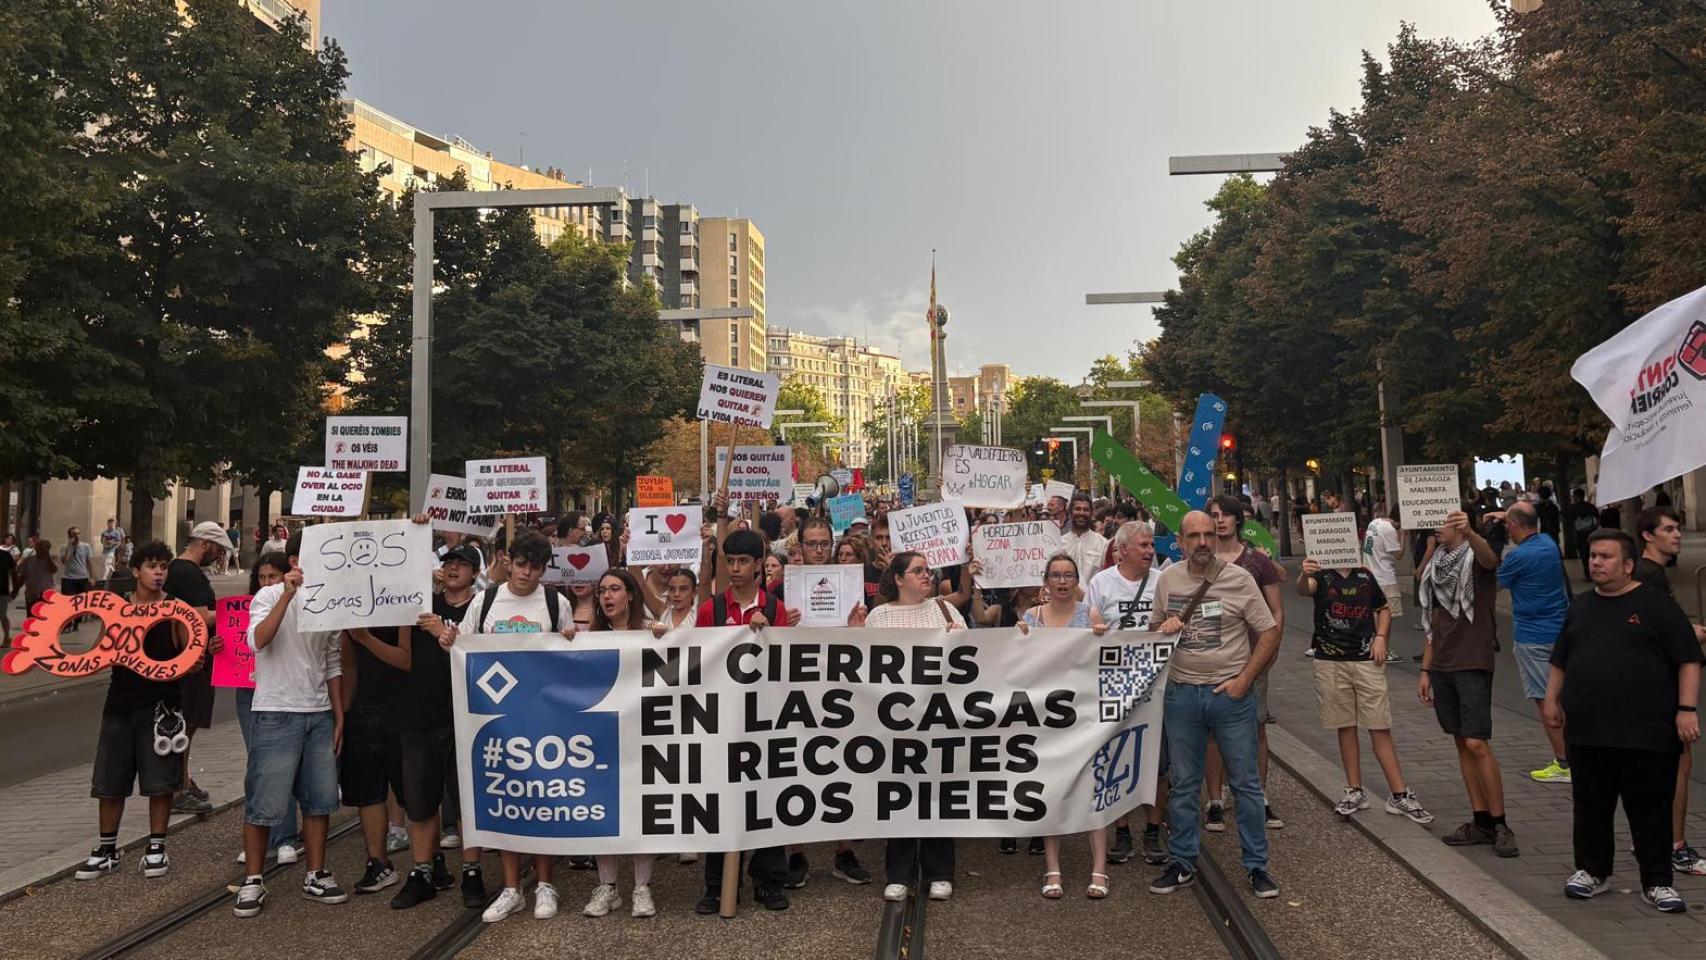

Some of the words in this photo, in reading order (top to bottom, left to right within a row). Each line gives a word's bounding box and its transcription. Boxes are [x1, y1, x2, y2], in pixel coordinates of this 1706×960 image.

[717, 371, 728, 380] ES
[730, 374, 764, 389] LITERAL
[709, 383, 728, 395] NOS
[729, 387, 767, 403] QUIEREN
[717, 398, 749, 413] QUITAR
[698, 408, 710, 419] LA
[712, 411, 731, 423] VIDA
[331, 426, 339, 435] SI
[340, 424, 370, 436] QUERÉIS
[371, 425, 402, 436] ZOMBIES
[351, 444, 361, 452] OS
[362, 441, 379, 453] VÉIS
[750, 451, 785, 462] QUITÁIS
[331, 460, 346, 469] THE
[347, 460, 379, 470] WALKING
[380, 460, 399, 470] DEAD
[479, 465, 492, 474] ES
[493, 463, 531, 473] LITERAL
[733, 466, 745, 474] EL
[746, 466, 770, 476] OCIO,
[955, 458, 970, 474] ES
[1400, 465, 1455, 474] AYUNTAMIENTO
[306, 471, 321, 479] NO
[322, 471, 334, 479] AL
[745, 476, 780, 487] QUITÁIS
[974, 472, 1012, 490] HOGAR
[1404, 477, 1414, 485] DE
[1415, 475, 1451, 484] ZARAGOZA
[301, 482, 326, 490] OVER
[341, 483, 363, 491] OCIO
[475, 478, 494, 488] NOS
[496, 477, 536, 487] QUIEREN
[316, 493, 330, 502] EN
[331, 494, 343, 502] LA
[445, 486, 467, 501] ERRO
[486, 490, 521, 500] QUITAR
[744, 489, 780, 500] SUEÑOS
[1409, 486, 1447, 495] MALTRATA
[311, 505, 345, 513] CIUDAD
[427, 506, 449, 521] OCIO
[449, 509, 467, 521] NOT
[470, 505, 481, 514] LA
[484, 504, 506, 513] VIDA
[507, 503, 540, 513] SOCIAL
[1425, 509, 1448, 517] ZONAS
[645, 514, 659, 535] I
[895, 517, 906, 532] LA
[906, 506, 955, 526] JUVENTUD
[1304, 517, 1354, 526] AYUNTAMIENTO
[900, 525, 941, 544] NECESITA
[942, 522, 960, 535] SER
[983, 522, 1025, 539] HORIZON
[1028, 522, 1043, 535] CON
[1318, 527, 1351, 535] ZARAGOZA
[948, 535, 959, 546] NO
[986, 538, 1011, 551] ZONA
[1316, 537, 1346, 545] MARGINA
[631, 549, 662, 561] ZONA
[664, 547, 699, 561] JOVEN
[1324, 548, 1356, 556] JUVENTUD
[547, 553, 560, 569] I
[303, 584, 363, 614] Zonas
[352, 575, 424, 617] Jóvenes
[120, 603, 159, 619] CASAS
[162, 601, 204, 650] juventud
[99, 622, 145, 654] SOS
[34, 643, 101, 674] ZONAS
[109, 652, 178, 679] JOVENES
[642, 646, 702, 687] NI
[726, 642, 979, 686] CIERRES
[641, 693, 719, 736] EN
[745, 688, 855, 733] LAS
[877, 689, 1077, 732] CASAS
[482, 734, 608, 771] #SOS_
[642, 743, 701, 785] NI
[728, 734, 1039, 784] RECORTES
[485, 771, 586, 799] Zonas
[1093, 783, 1121, 812] ZGZ
[487, 797, 606, 822] Jovenes
[641, 793, 719, 835] EN
[746, 781, 854, 831] LOS
[877, 780, 1047, 822] PIEES
